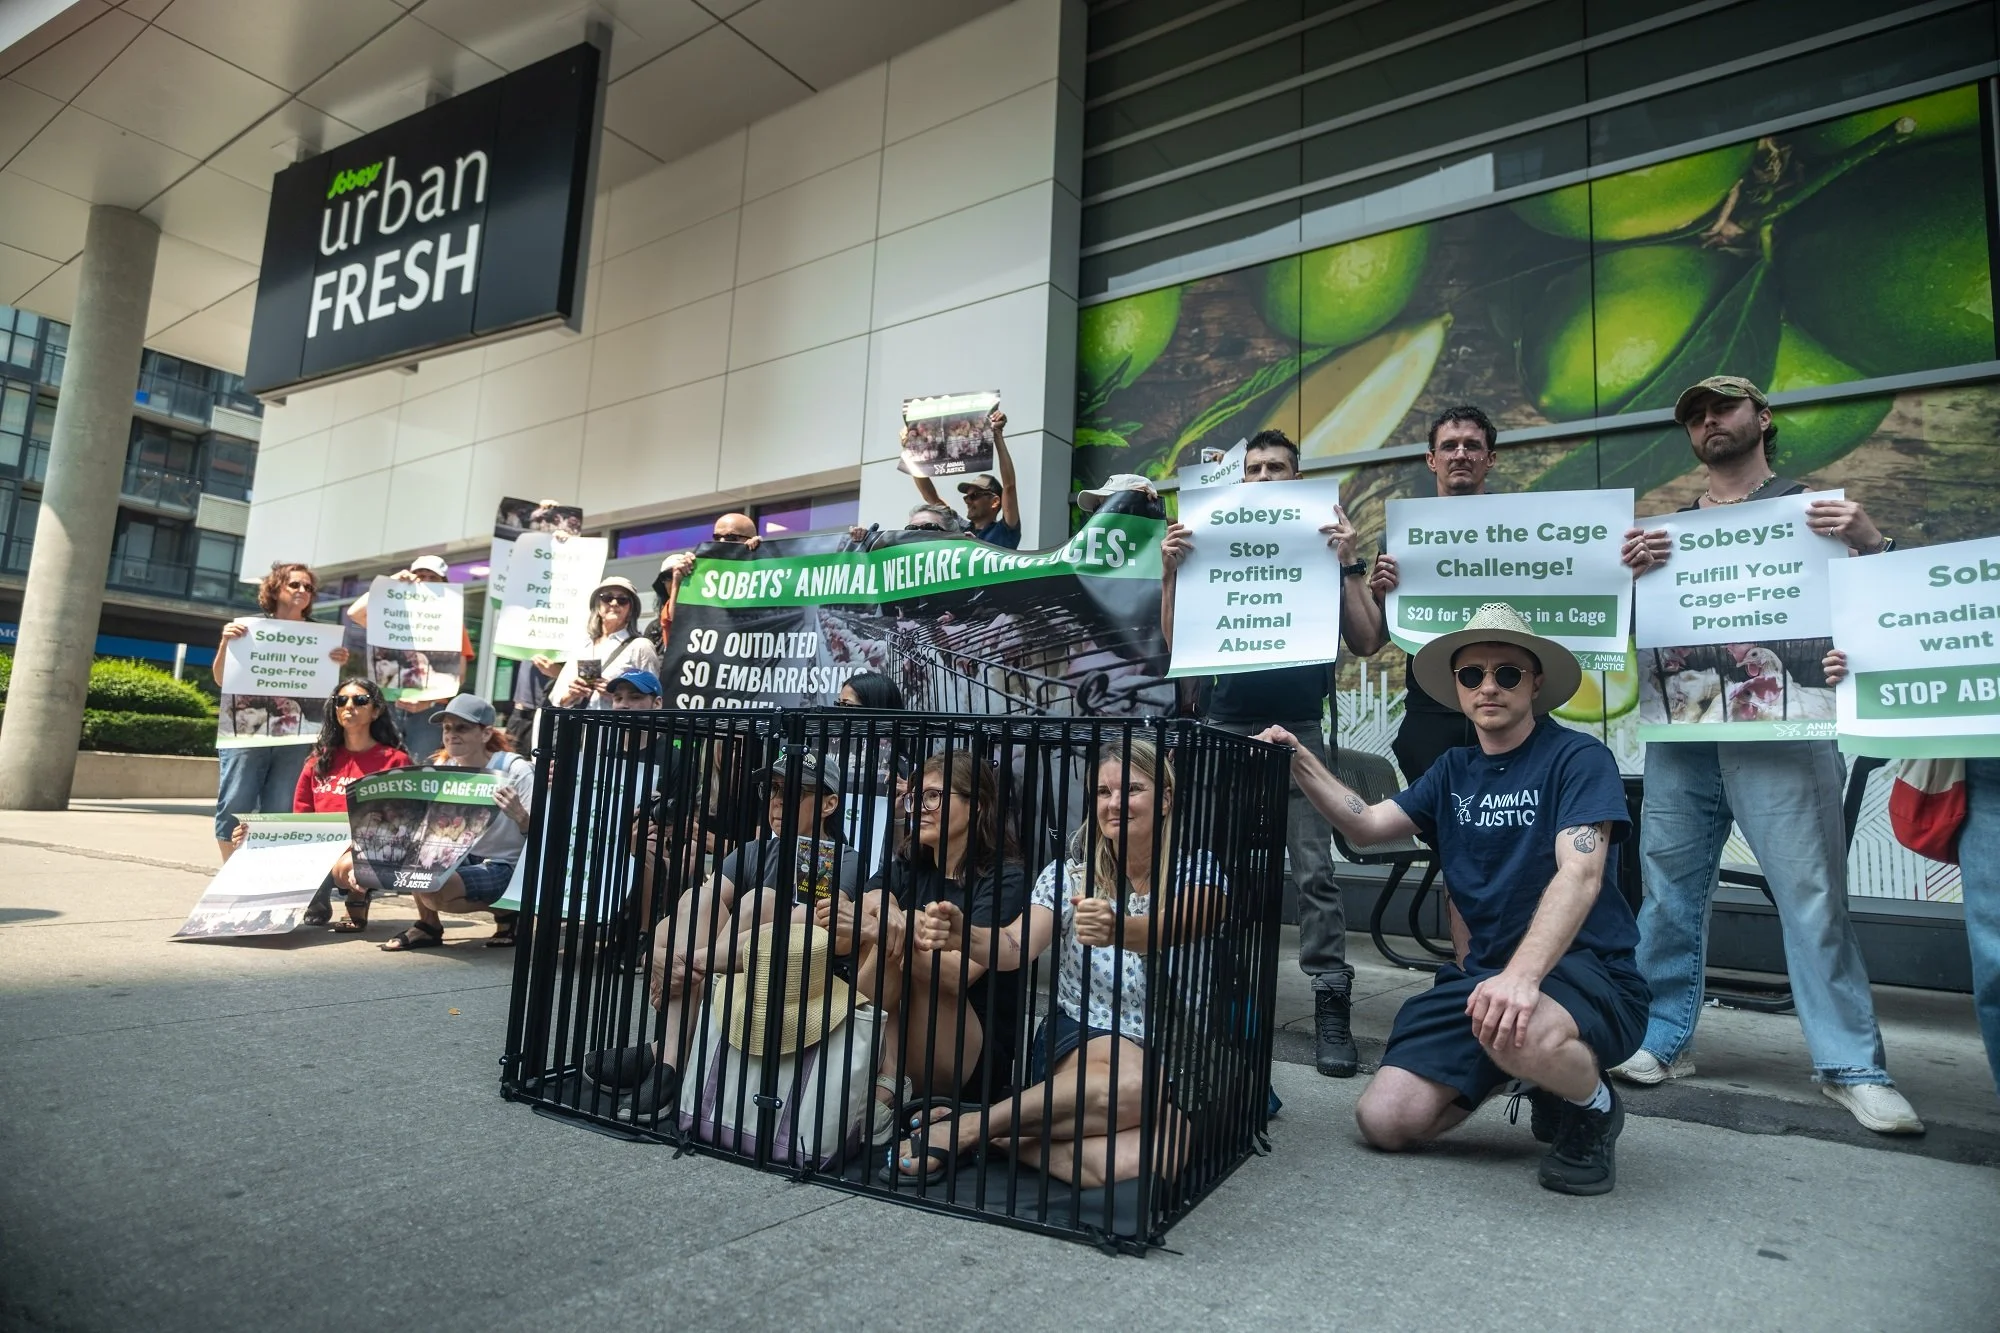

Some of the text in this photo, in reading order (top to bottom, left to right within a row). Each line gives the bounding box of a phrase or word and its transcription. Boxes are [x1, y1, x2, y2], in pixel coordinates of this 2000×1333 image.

[319, 149, 489, 256] urban
[307, 223, 481, 339] FRESH
[1210, 507, 1301, 526] Sobeys:
[1408, 522, 1608, 545] Brave the Cage
[1678, 521, 1795, 552] Sobeys:
[1229, 542, 1280, 559] Stop
[701, 568, 792, 600] SOBEYS’
[794, 564, 879, 597] ANIMAL
[882, 546, 968, 592] WELFARE
[1209, 565, 1302, 583] Profiting
[1436, 557, 1574, 580] Challenge!
[1675, 559, 1804, 586] Fulfill Your
[526, 583, 578, 596] Profng
[1226, 591, 1283, 606] From
[1678, 584, 1801, 610] Cage-Free
[383, 607, 442, 619] Fulfill Your
[528, 613, 569, 625] Animal
[1215, 612, 1292, 630] Animal
[1407, 606, 1433, 622] $20
[1437, 607, 1458, 622] for
[1462, 608, 1471, 623] 5
[1536, 608, 1550, 622] in
[1555, 611, 1564, 623] a
[1568, 607, 1606, 627] Cage
[1692, 609, 1788, 630] Promise
[1878, 604, 2000, 628] Canadia
[383, 620, 440, 631] Cage-Free
[255, 630, 318, 646] Sobeys:
[388, 633, 434, 643] Promise
[687, 628, 818, 659] SO OUTDATED
[1218, 638, 1286, 653] Abuse
[1919, 631, 1994, 651] want
[250, 651, 319, 664] Fulfill Your
[1592, 662, 1625, 671] JUSTICE
[1594, 654, 1625, 663] ANIMAL
[250, 665, 316, 677] Cage-Free
[680, 660, 868, 694] SO EMBARRASSIN
[256, 679, 308, 690] Promise
[1879, 677, 2000, 706] STOP AB
[359, 779, 417, 797] SOBEYS:
[421, 779, 439, 794] GO
[247, 831, 348, 843] 100% Cage-Free!
[406, 880, 430, 889] JUSTICE
[409, 872, 433, 881] ANIMAL
